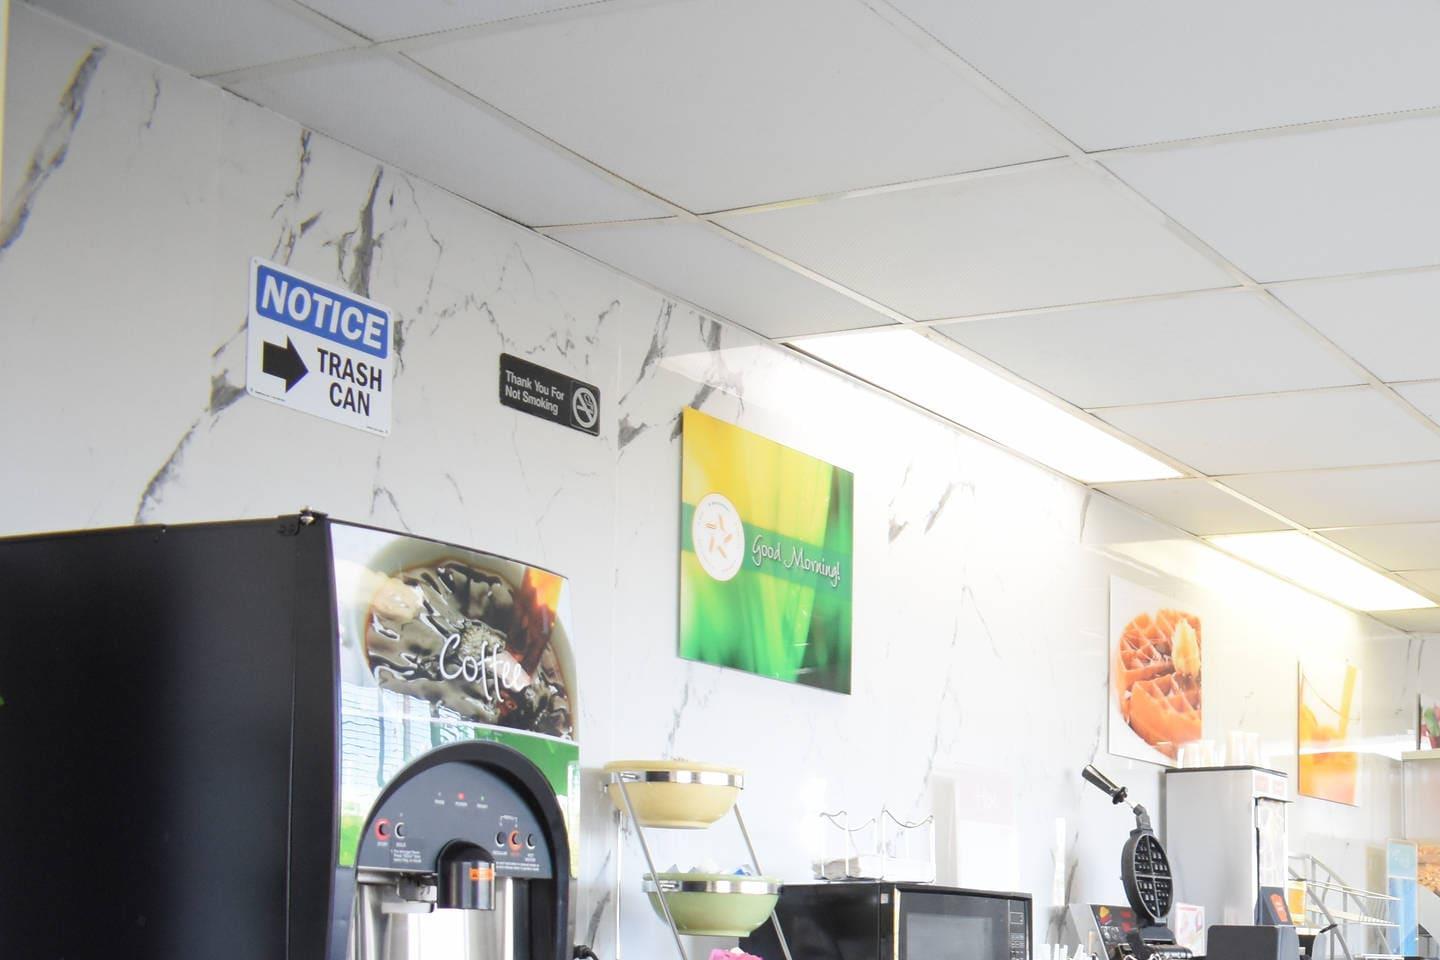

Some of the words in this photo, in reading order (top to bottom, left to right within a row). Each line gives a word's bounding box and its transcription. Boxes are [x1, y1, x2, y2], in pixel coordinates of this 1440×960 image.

[261, 275, 386, 350] NOTICE
[317, 347, 383, 393] TRASH
[505, 369, 532, 390] Thank
[534, 380, 550, 396] You
[551, 386, 565, 401] For
[329, 382, 371, 417] CAN
[505, 384, 522, 400] Not
[522, 391, 559, 416] Smoking
[752, 534, 782, 567] Good
[783, 545, 841, 587] Morning!
[440, 633, 531, 702] Coffee
